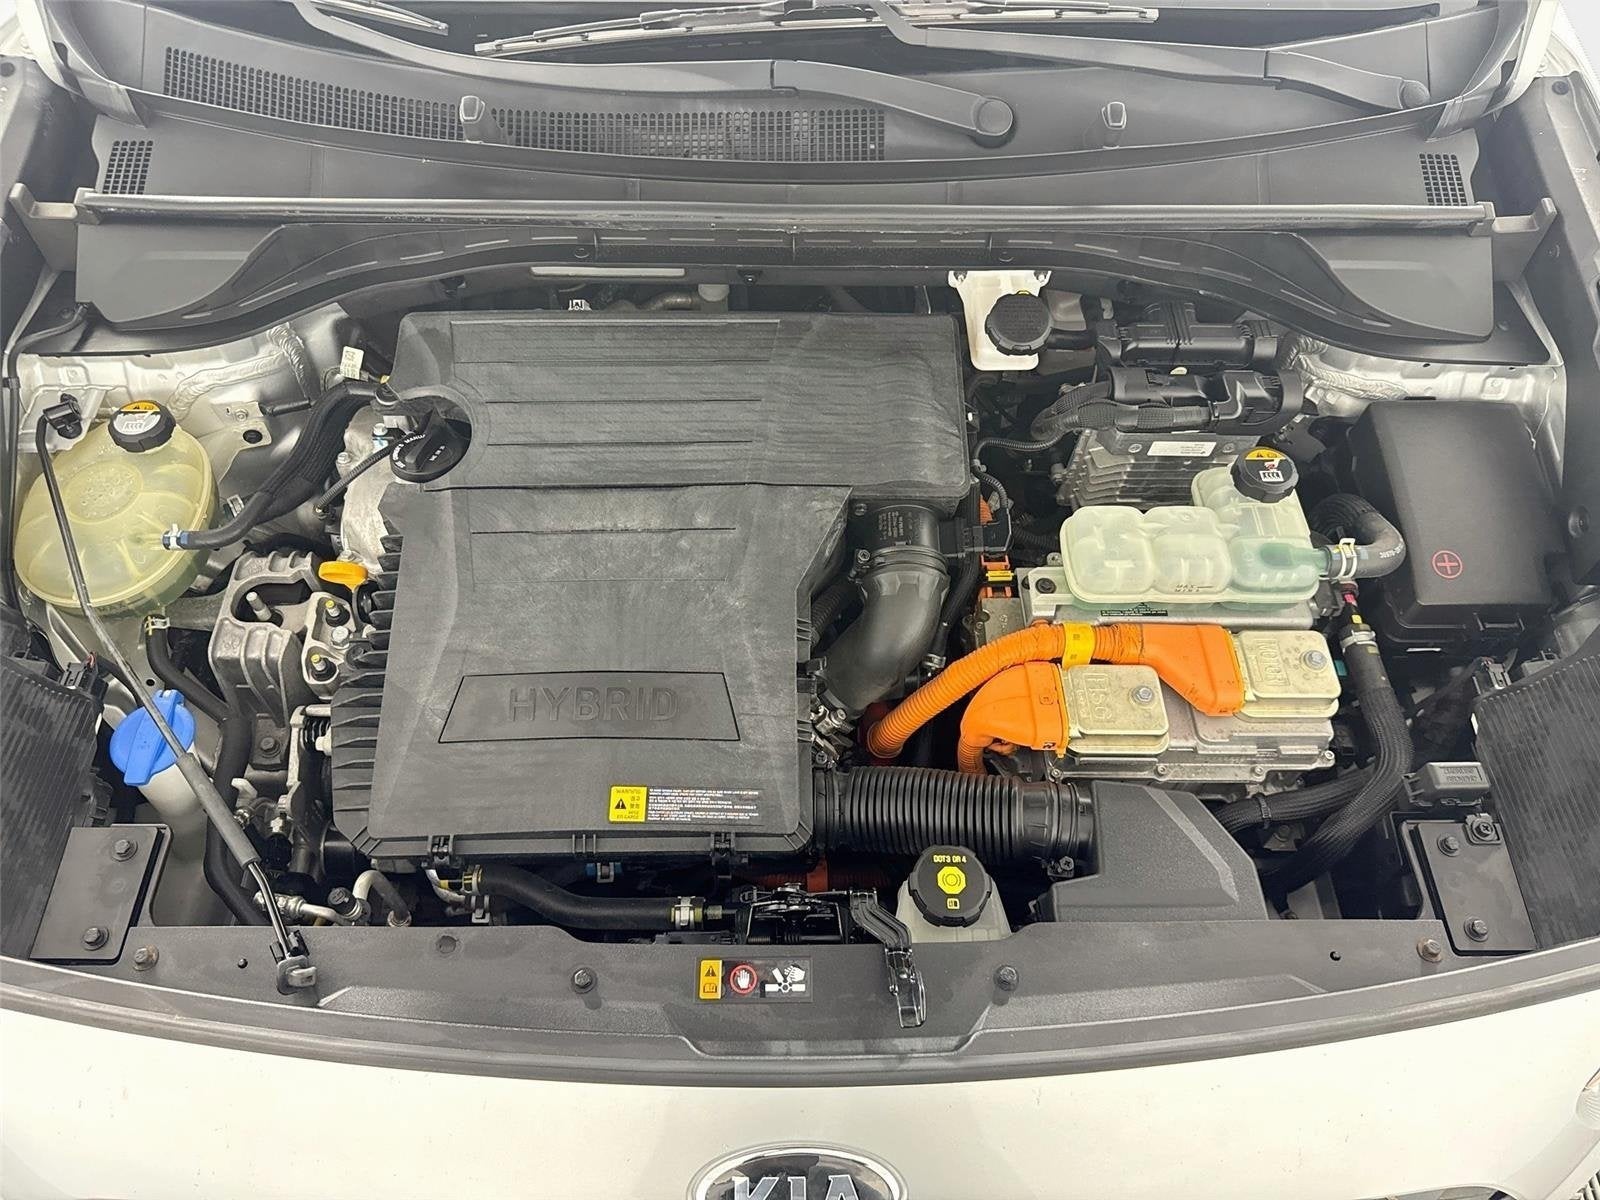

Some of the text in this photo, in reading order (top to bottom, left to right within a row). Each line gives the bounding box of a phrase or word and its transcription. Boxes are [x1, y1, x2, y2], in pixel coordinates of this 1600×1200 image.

[508, 686, 679, 722] HYBRID
[933, 854, 951, 863] DOT3
[961, 855, 967, 863] 4
